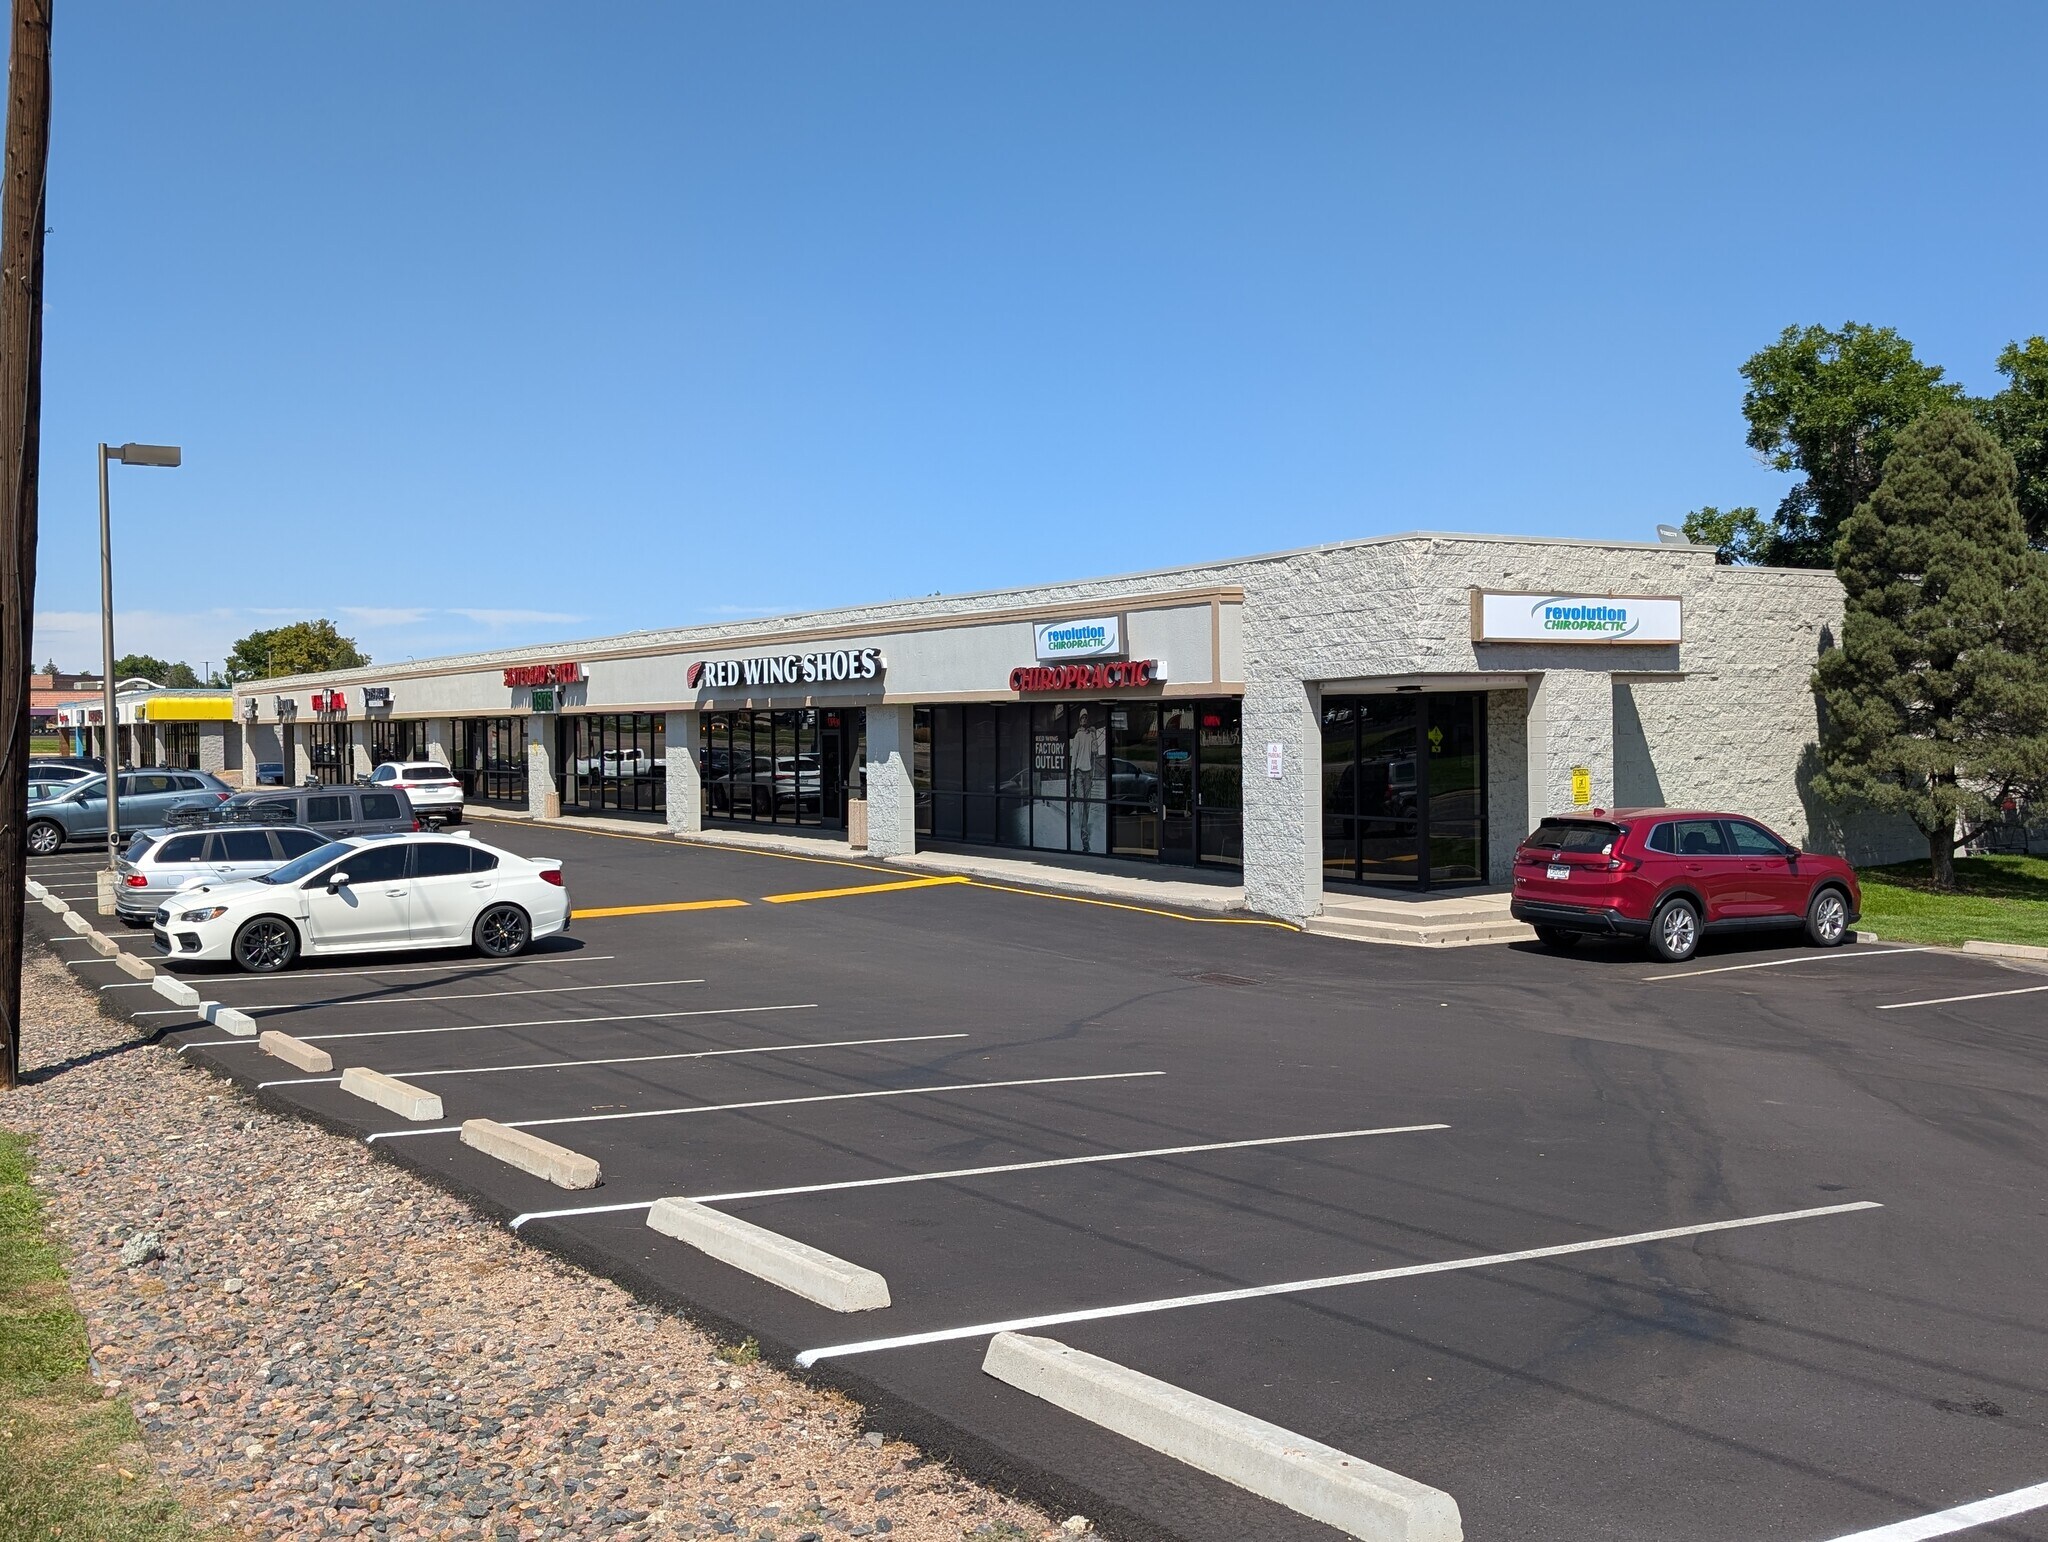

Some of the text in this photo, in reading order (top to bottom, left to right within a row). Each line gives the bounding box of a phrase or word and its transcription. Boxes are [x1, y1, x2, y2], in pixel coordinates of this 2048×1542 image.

[1545, 605, 1627, 622] revolution
[1544, 619, 1628, 632] CHIROPRACTIC
[1047, 626, 1106, 642] revolution
[1048, 637, 1106, 650] CHIROPRACTIC
[704, 648, 877, 688] RED WING SHOES
[1009, 660, 1151, 692] CHIROPRACTIC
[1035, 742, 1065, 755] FACTORY
[1035, 755, 1065, 770] OUTLET
